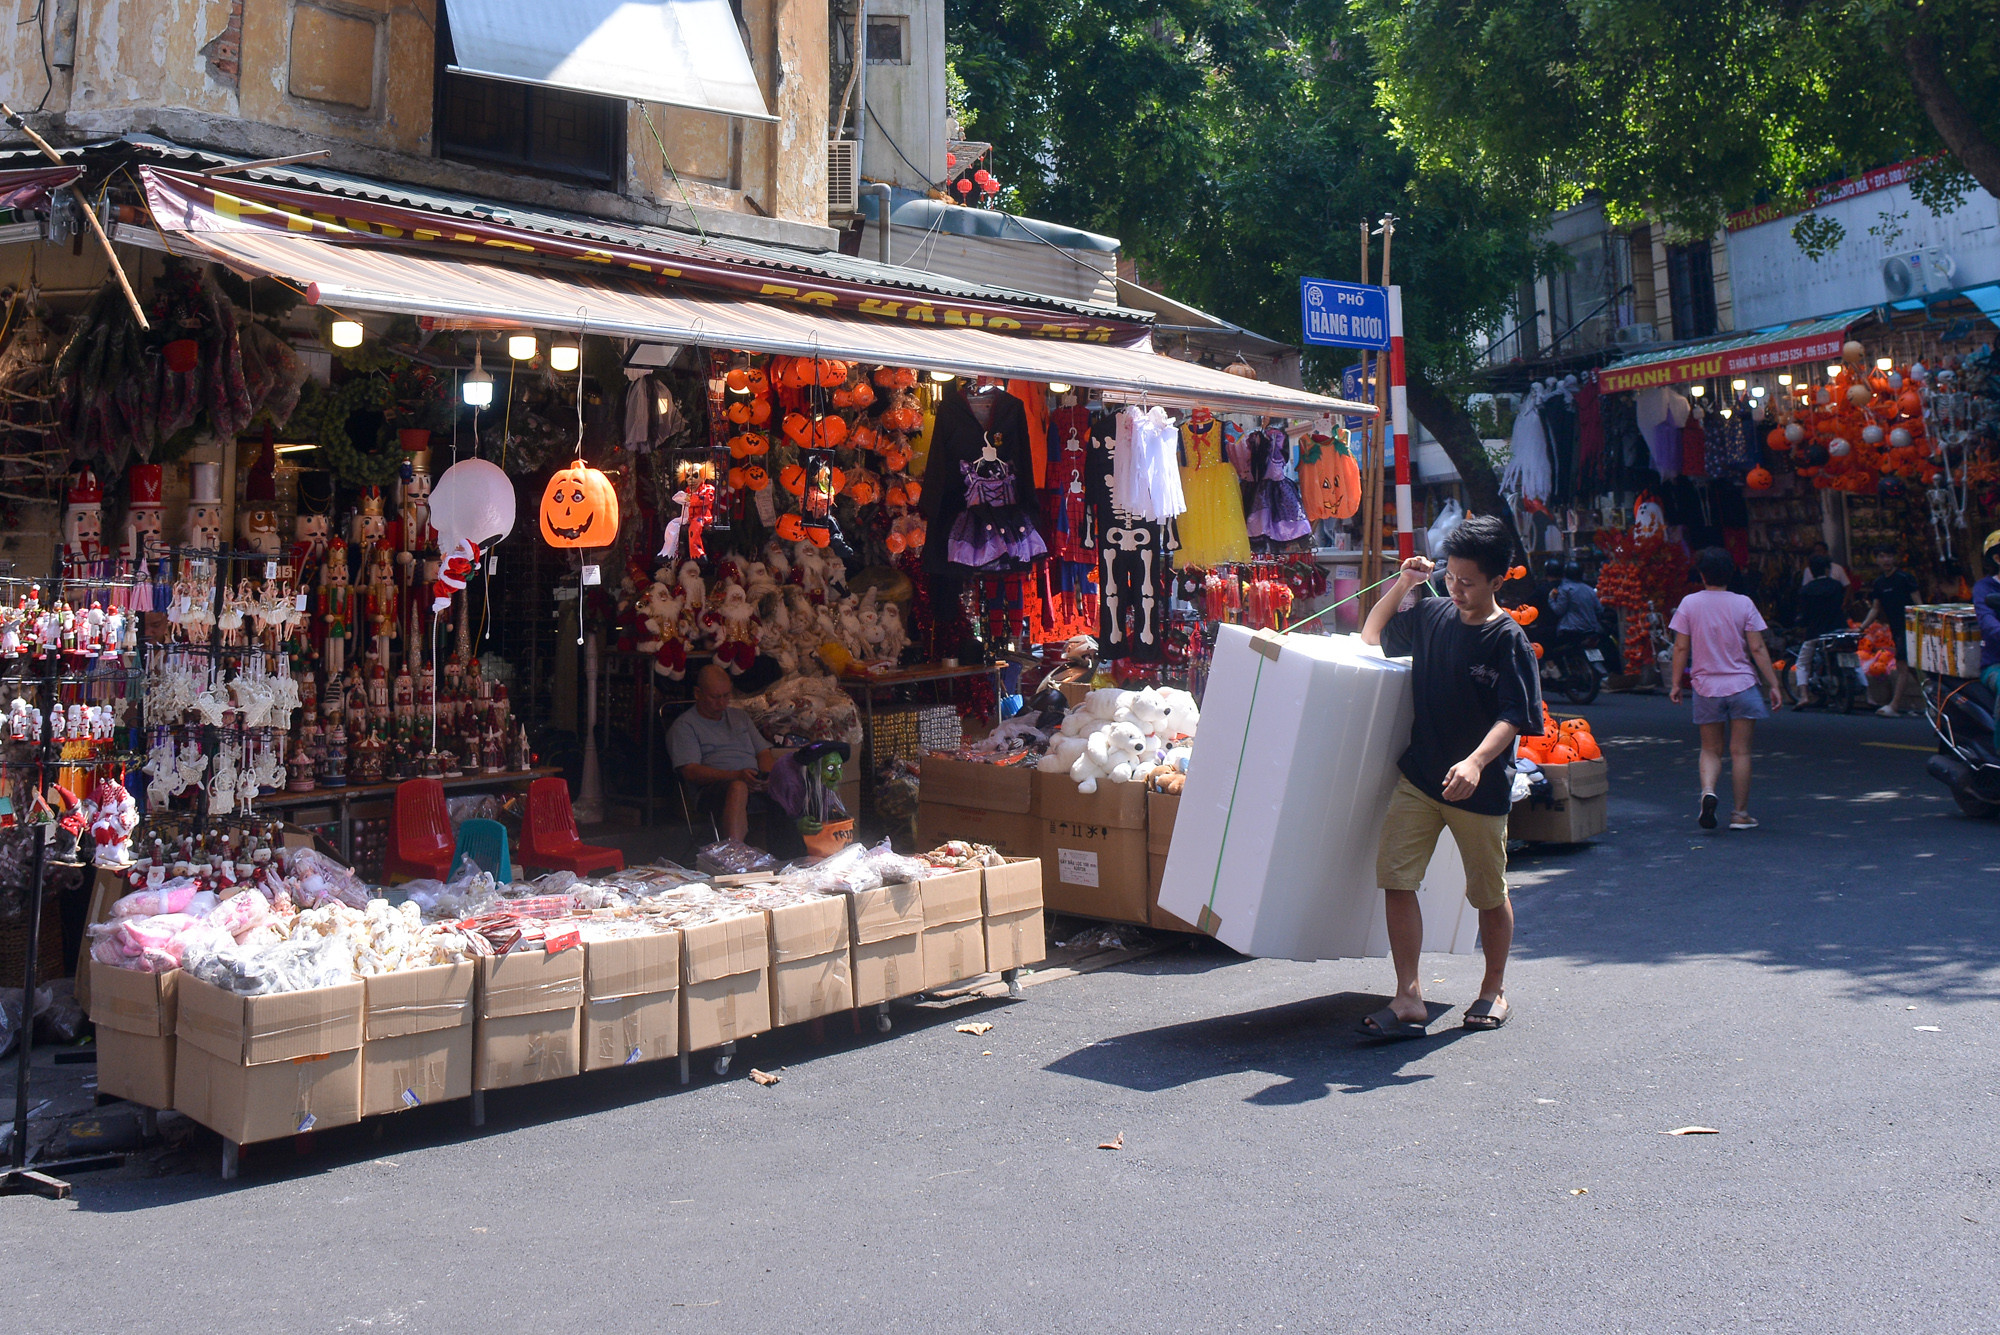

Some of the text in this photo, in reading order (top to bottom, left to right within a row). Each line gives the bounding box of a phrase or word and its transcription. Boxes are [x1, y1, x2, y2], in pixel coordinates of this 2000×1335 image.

[1338, 291, 1365, 306] PHỐ
[1310, 306, 1382, 340] HÀNG RƯƠI
[1605, 367, 1671, 391] THANH
[1678, 356, 1723, 380] THƯ
